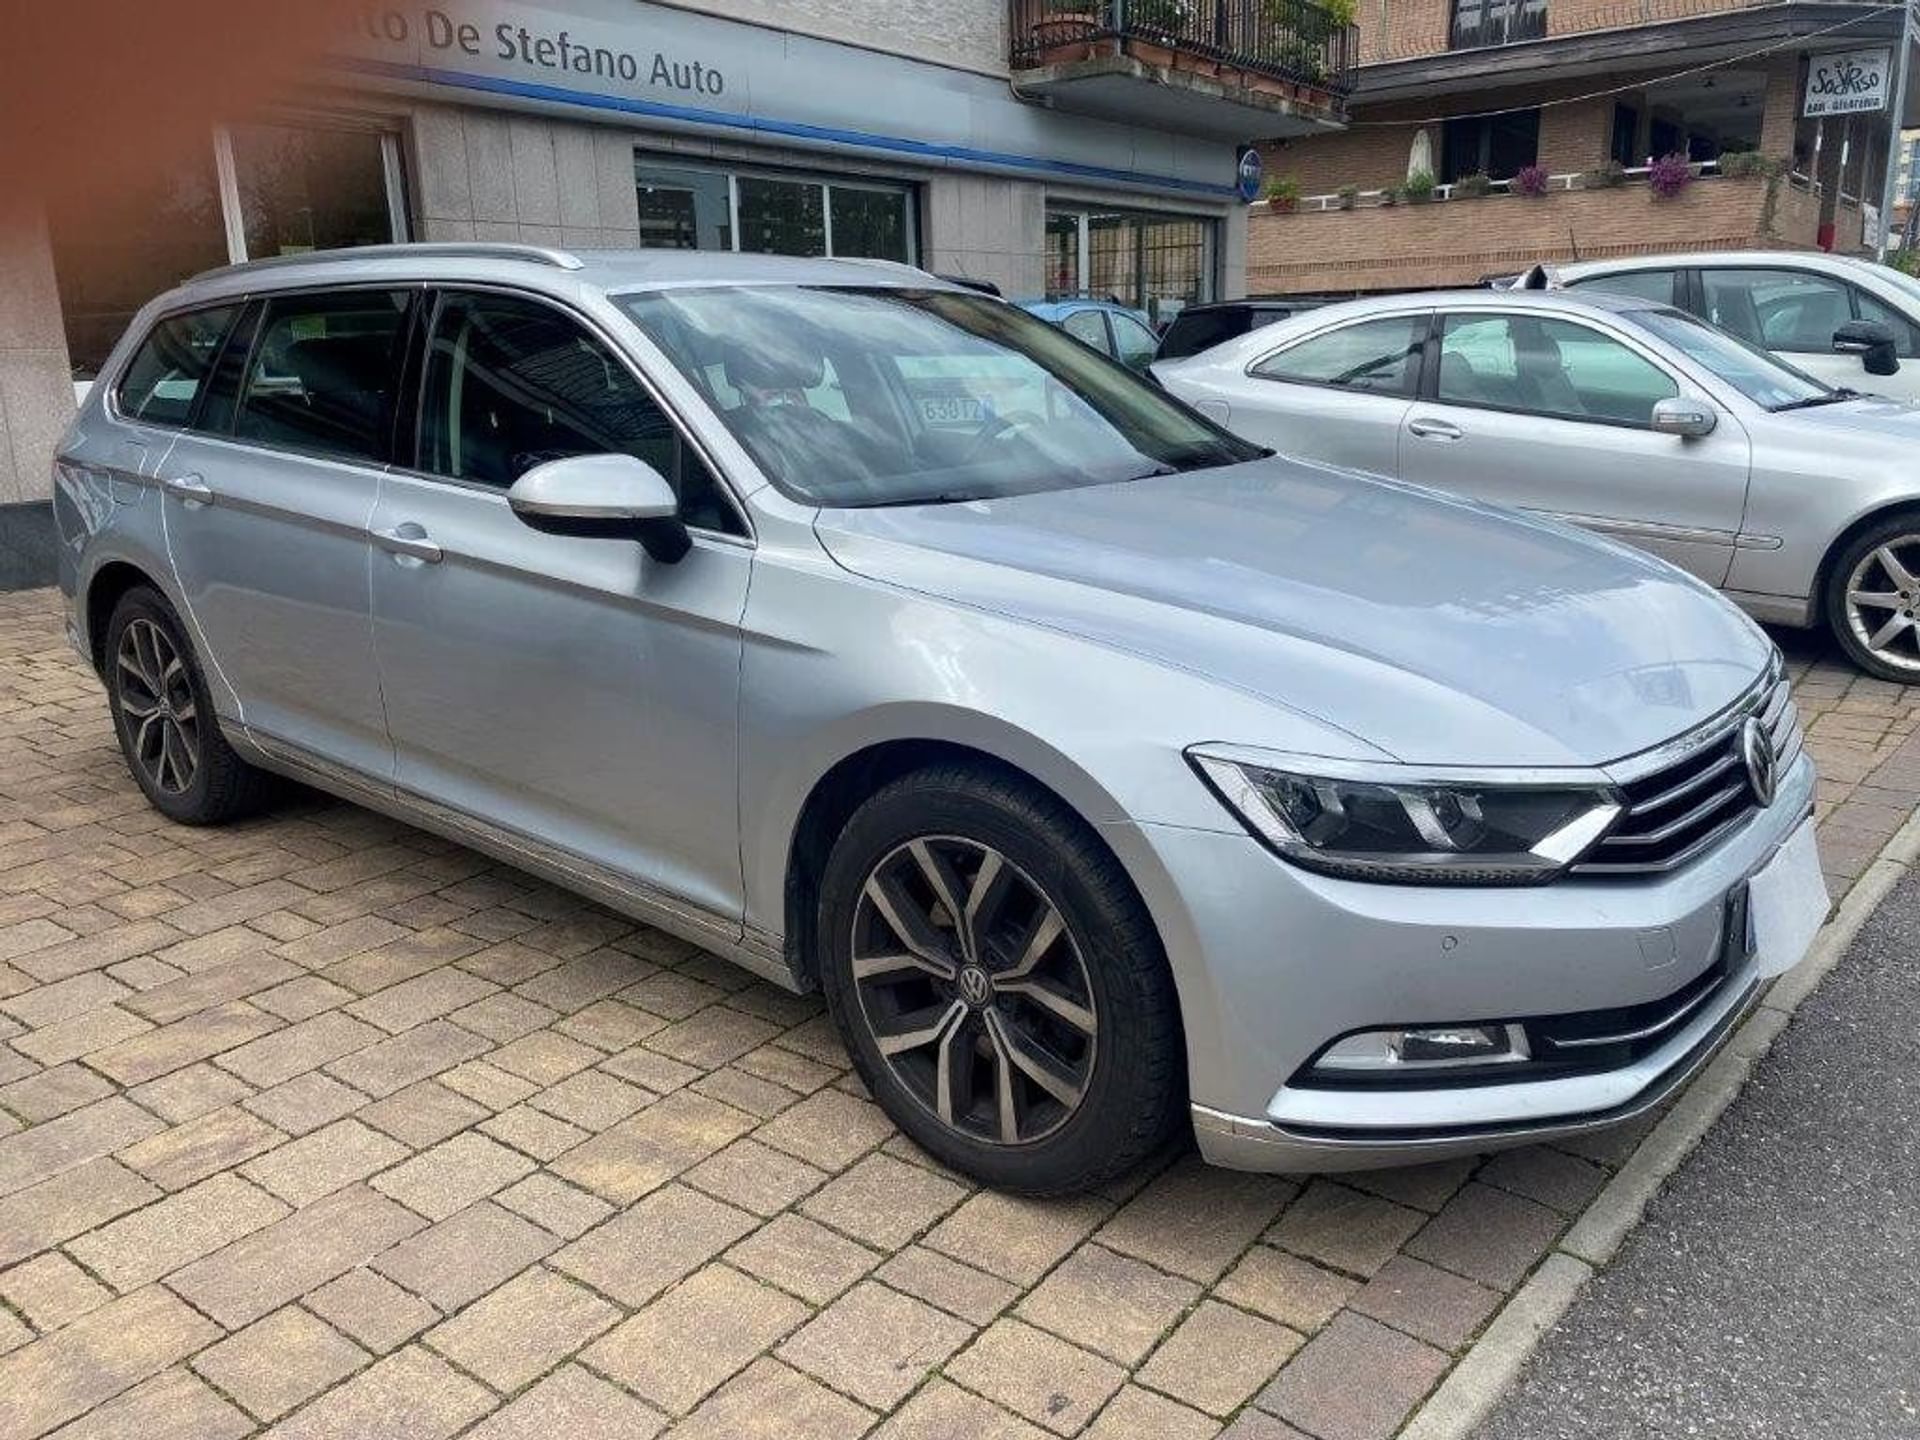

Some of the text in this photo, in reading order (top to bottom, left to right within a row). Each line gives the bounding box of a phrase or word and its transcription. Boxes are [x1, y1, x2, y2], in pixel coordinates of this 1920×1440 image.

[426, 10, 480, 55] De
[496, 24, 637, 80] Stefano
[651, 53, 723, 94] Auto
